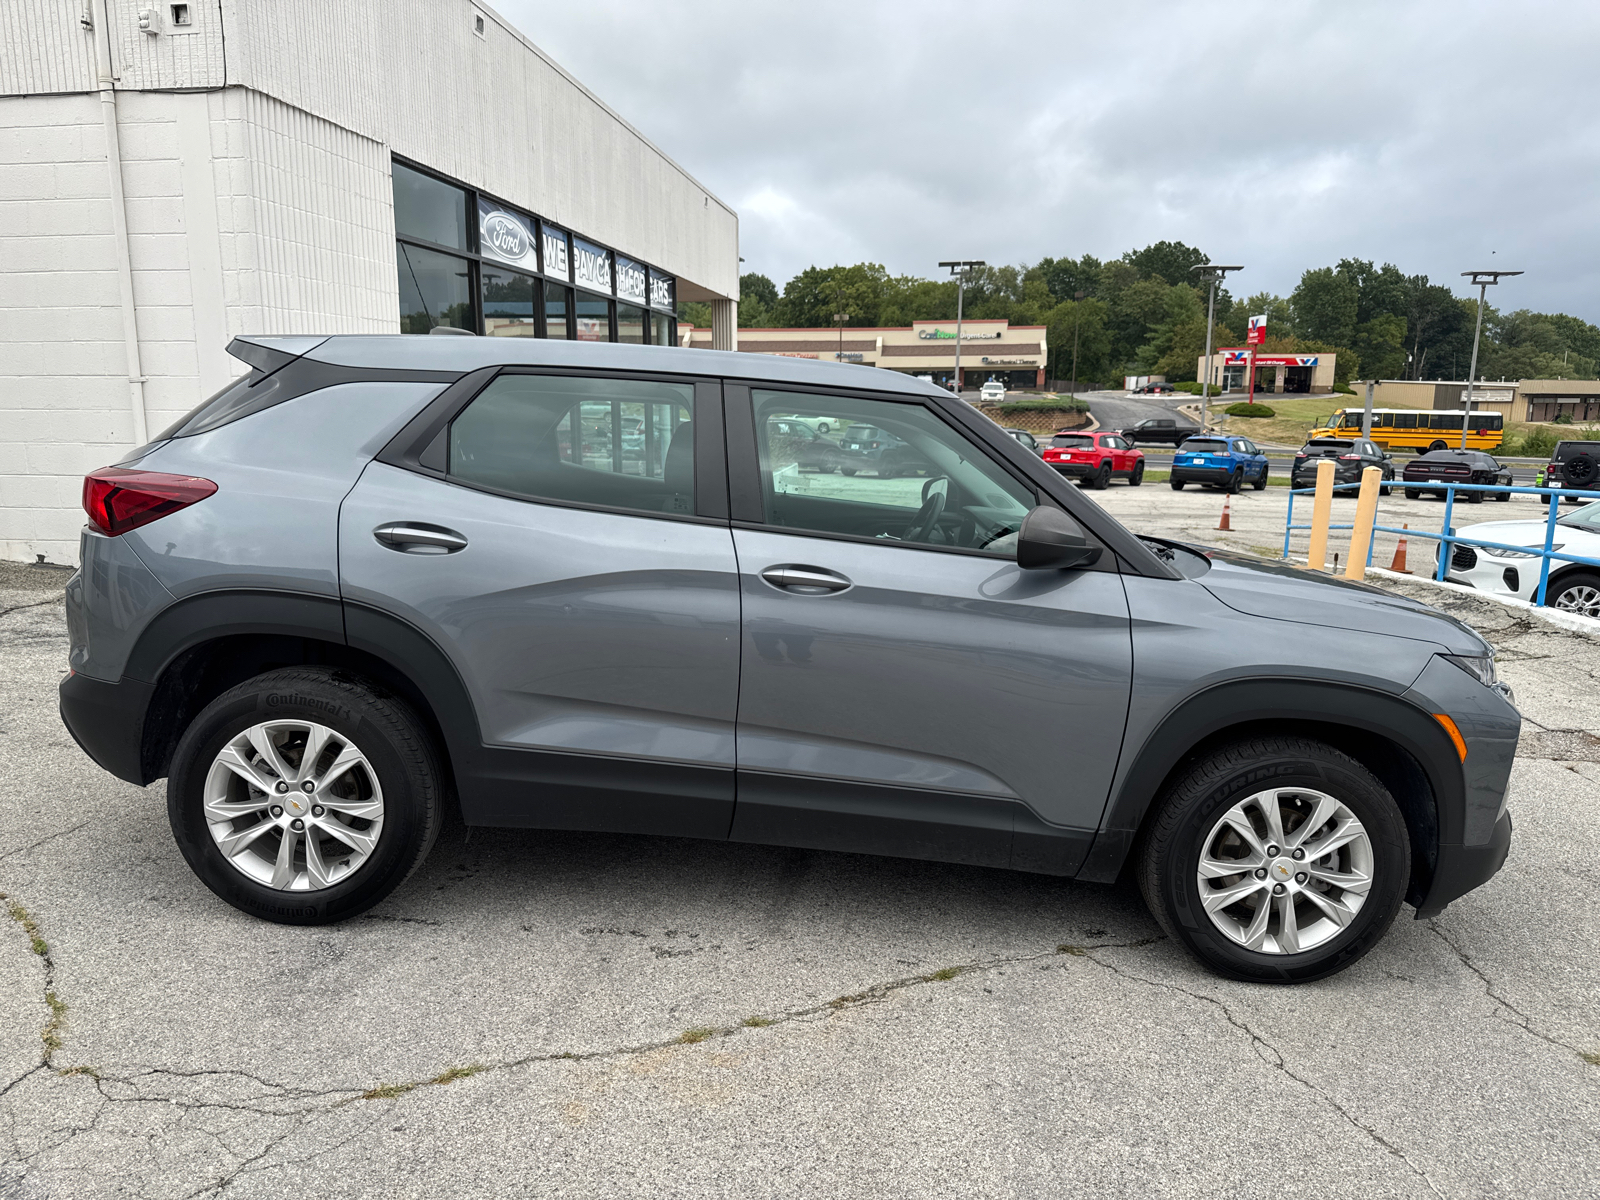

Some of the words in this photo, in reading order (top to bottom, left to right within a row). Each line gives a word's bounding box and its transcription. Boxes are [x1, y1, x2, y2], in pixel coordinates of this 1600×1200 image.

[493, 219, 521, 254] Ford
[542, 233, 567, 272] WE
[573, 246, 595, 282] PAY
[628, 268, 646, 297] FOR
[265, 692, 343, 716] Continental
[1191, 765, 1295, 830] TOURING
[243, 896, 319, 918] Continental
